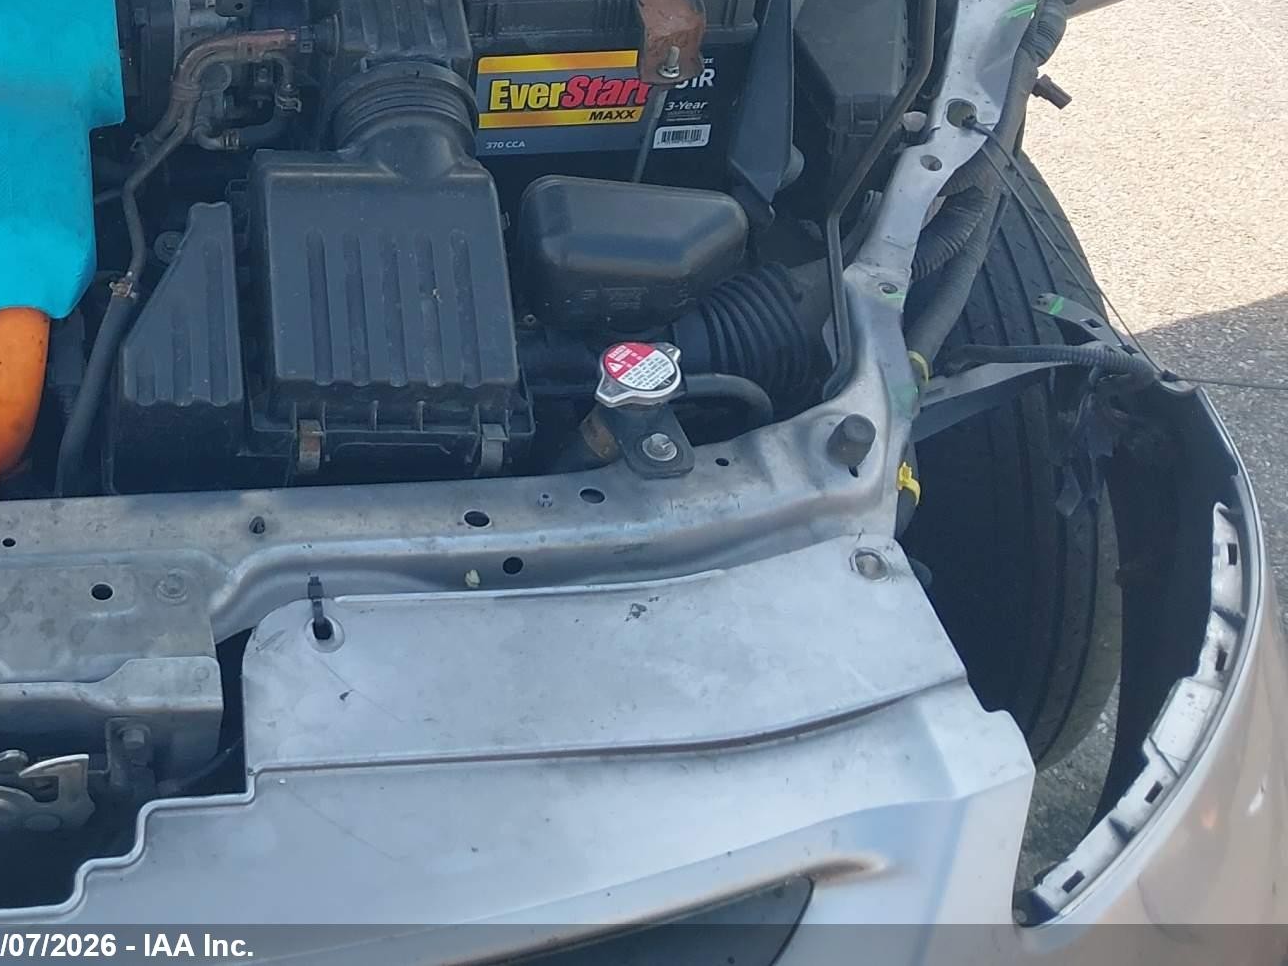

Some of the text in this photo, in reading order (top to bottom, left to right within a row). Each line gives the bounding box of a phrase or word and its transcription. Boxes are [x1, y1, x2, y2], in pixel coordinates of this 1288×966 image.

[489, 74, 651, 111] EverStart
[664, 100, 708, 111] 3-Year
[589, 109, 636, 122] MAXX
[486, 140, 526, 150] 370 CCA
